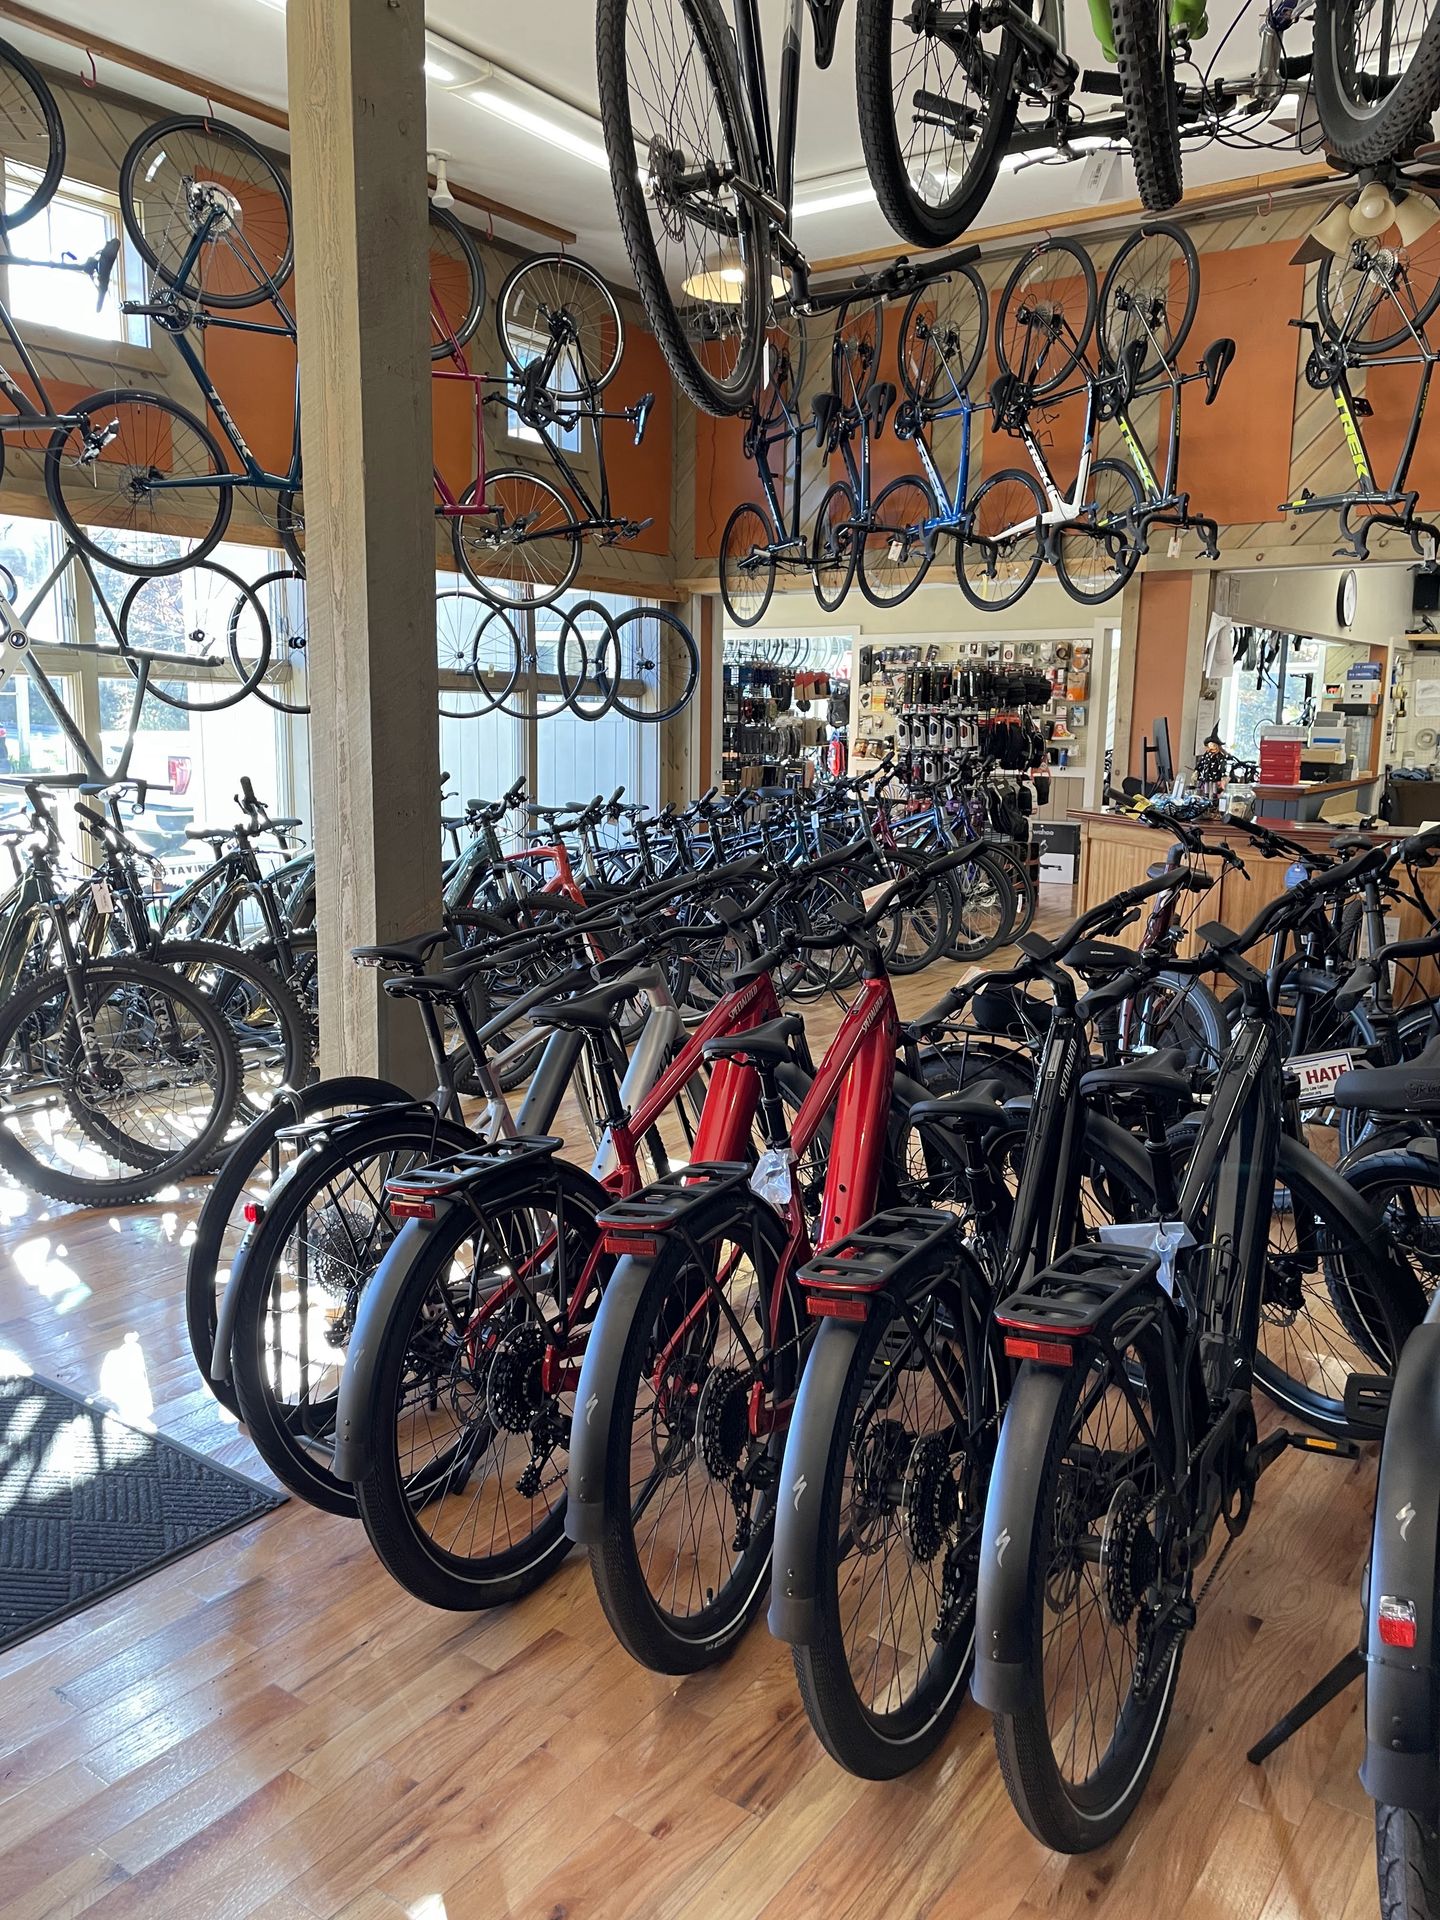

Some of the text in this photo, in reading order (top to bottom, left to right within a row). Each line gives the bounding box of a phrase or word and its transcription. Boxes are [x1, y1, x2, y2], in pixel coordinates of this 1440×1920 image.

[208, 385, 254, 458] TREK
[1335, 386, 1370, 479] TREK
[1119, 414, 1156, 491] TREK
[1033, 828, 1055, 836] wahoo
[728, 984, 759, 1023] SPECIALIZED
[81, 1015, 98, 1049] FOX
[1059, 1037, 1078, 1098] SPECIALIZED
[1306, 1064, 1347, 1084] HATE
